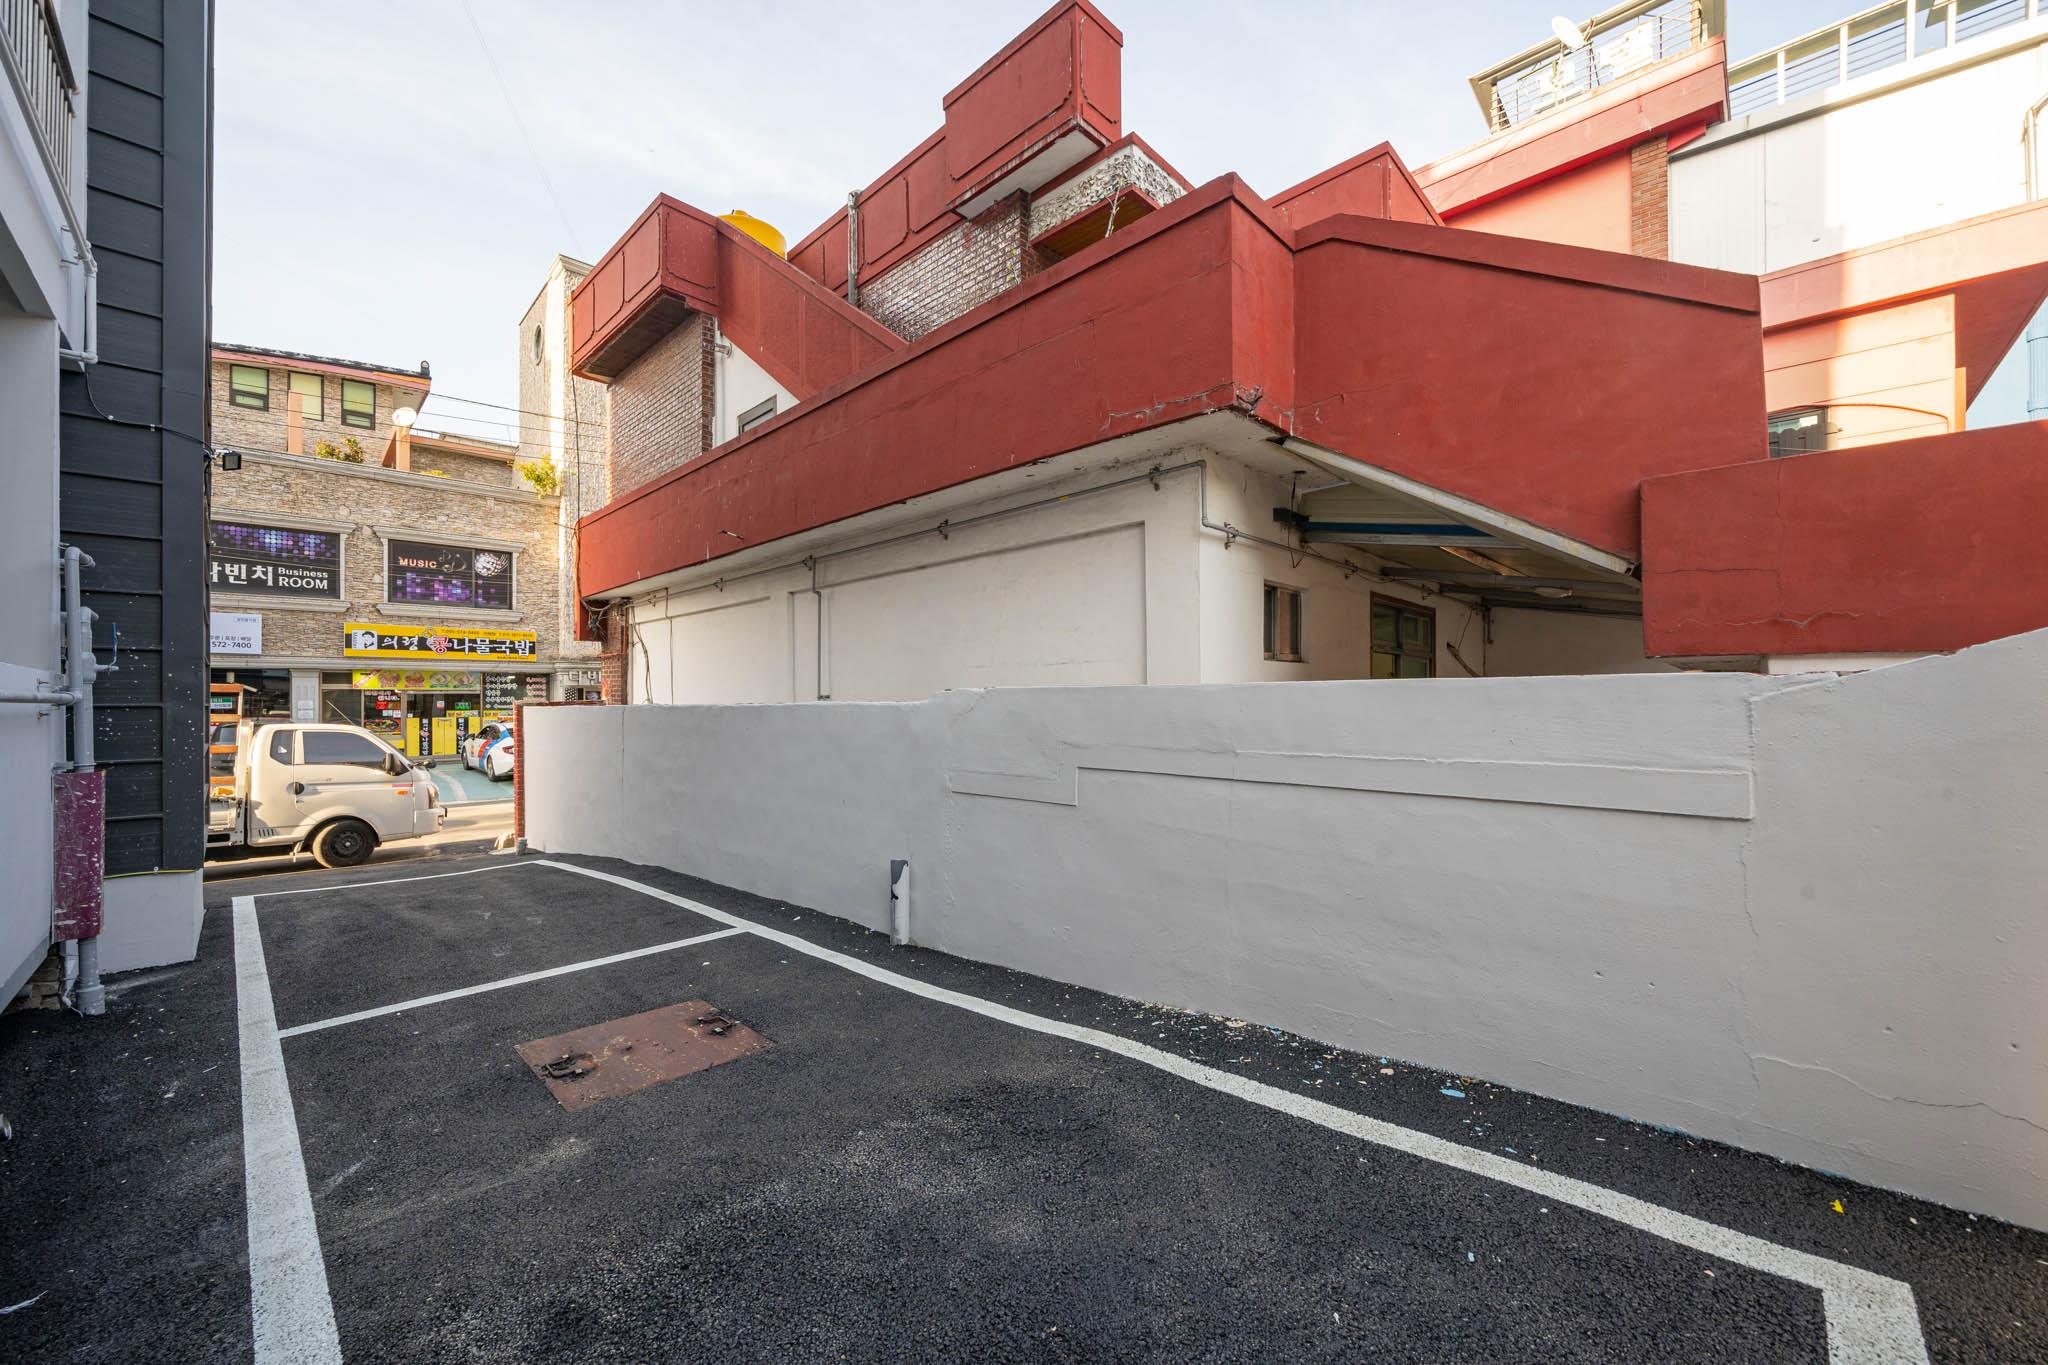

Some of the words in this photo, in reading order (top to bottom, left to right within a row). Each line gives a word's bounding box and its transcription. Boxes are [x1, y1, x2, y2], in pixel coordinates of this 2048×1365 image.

[399, 556, 438, 568] MUSIC
[278, 567, 329, 578] Business
[279, 576, 328, 590] ROOM
